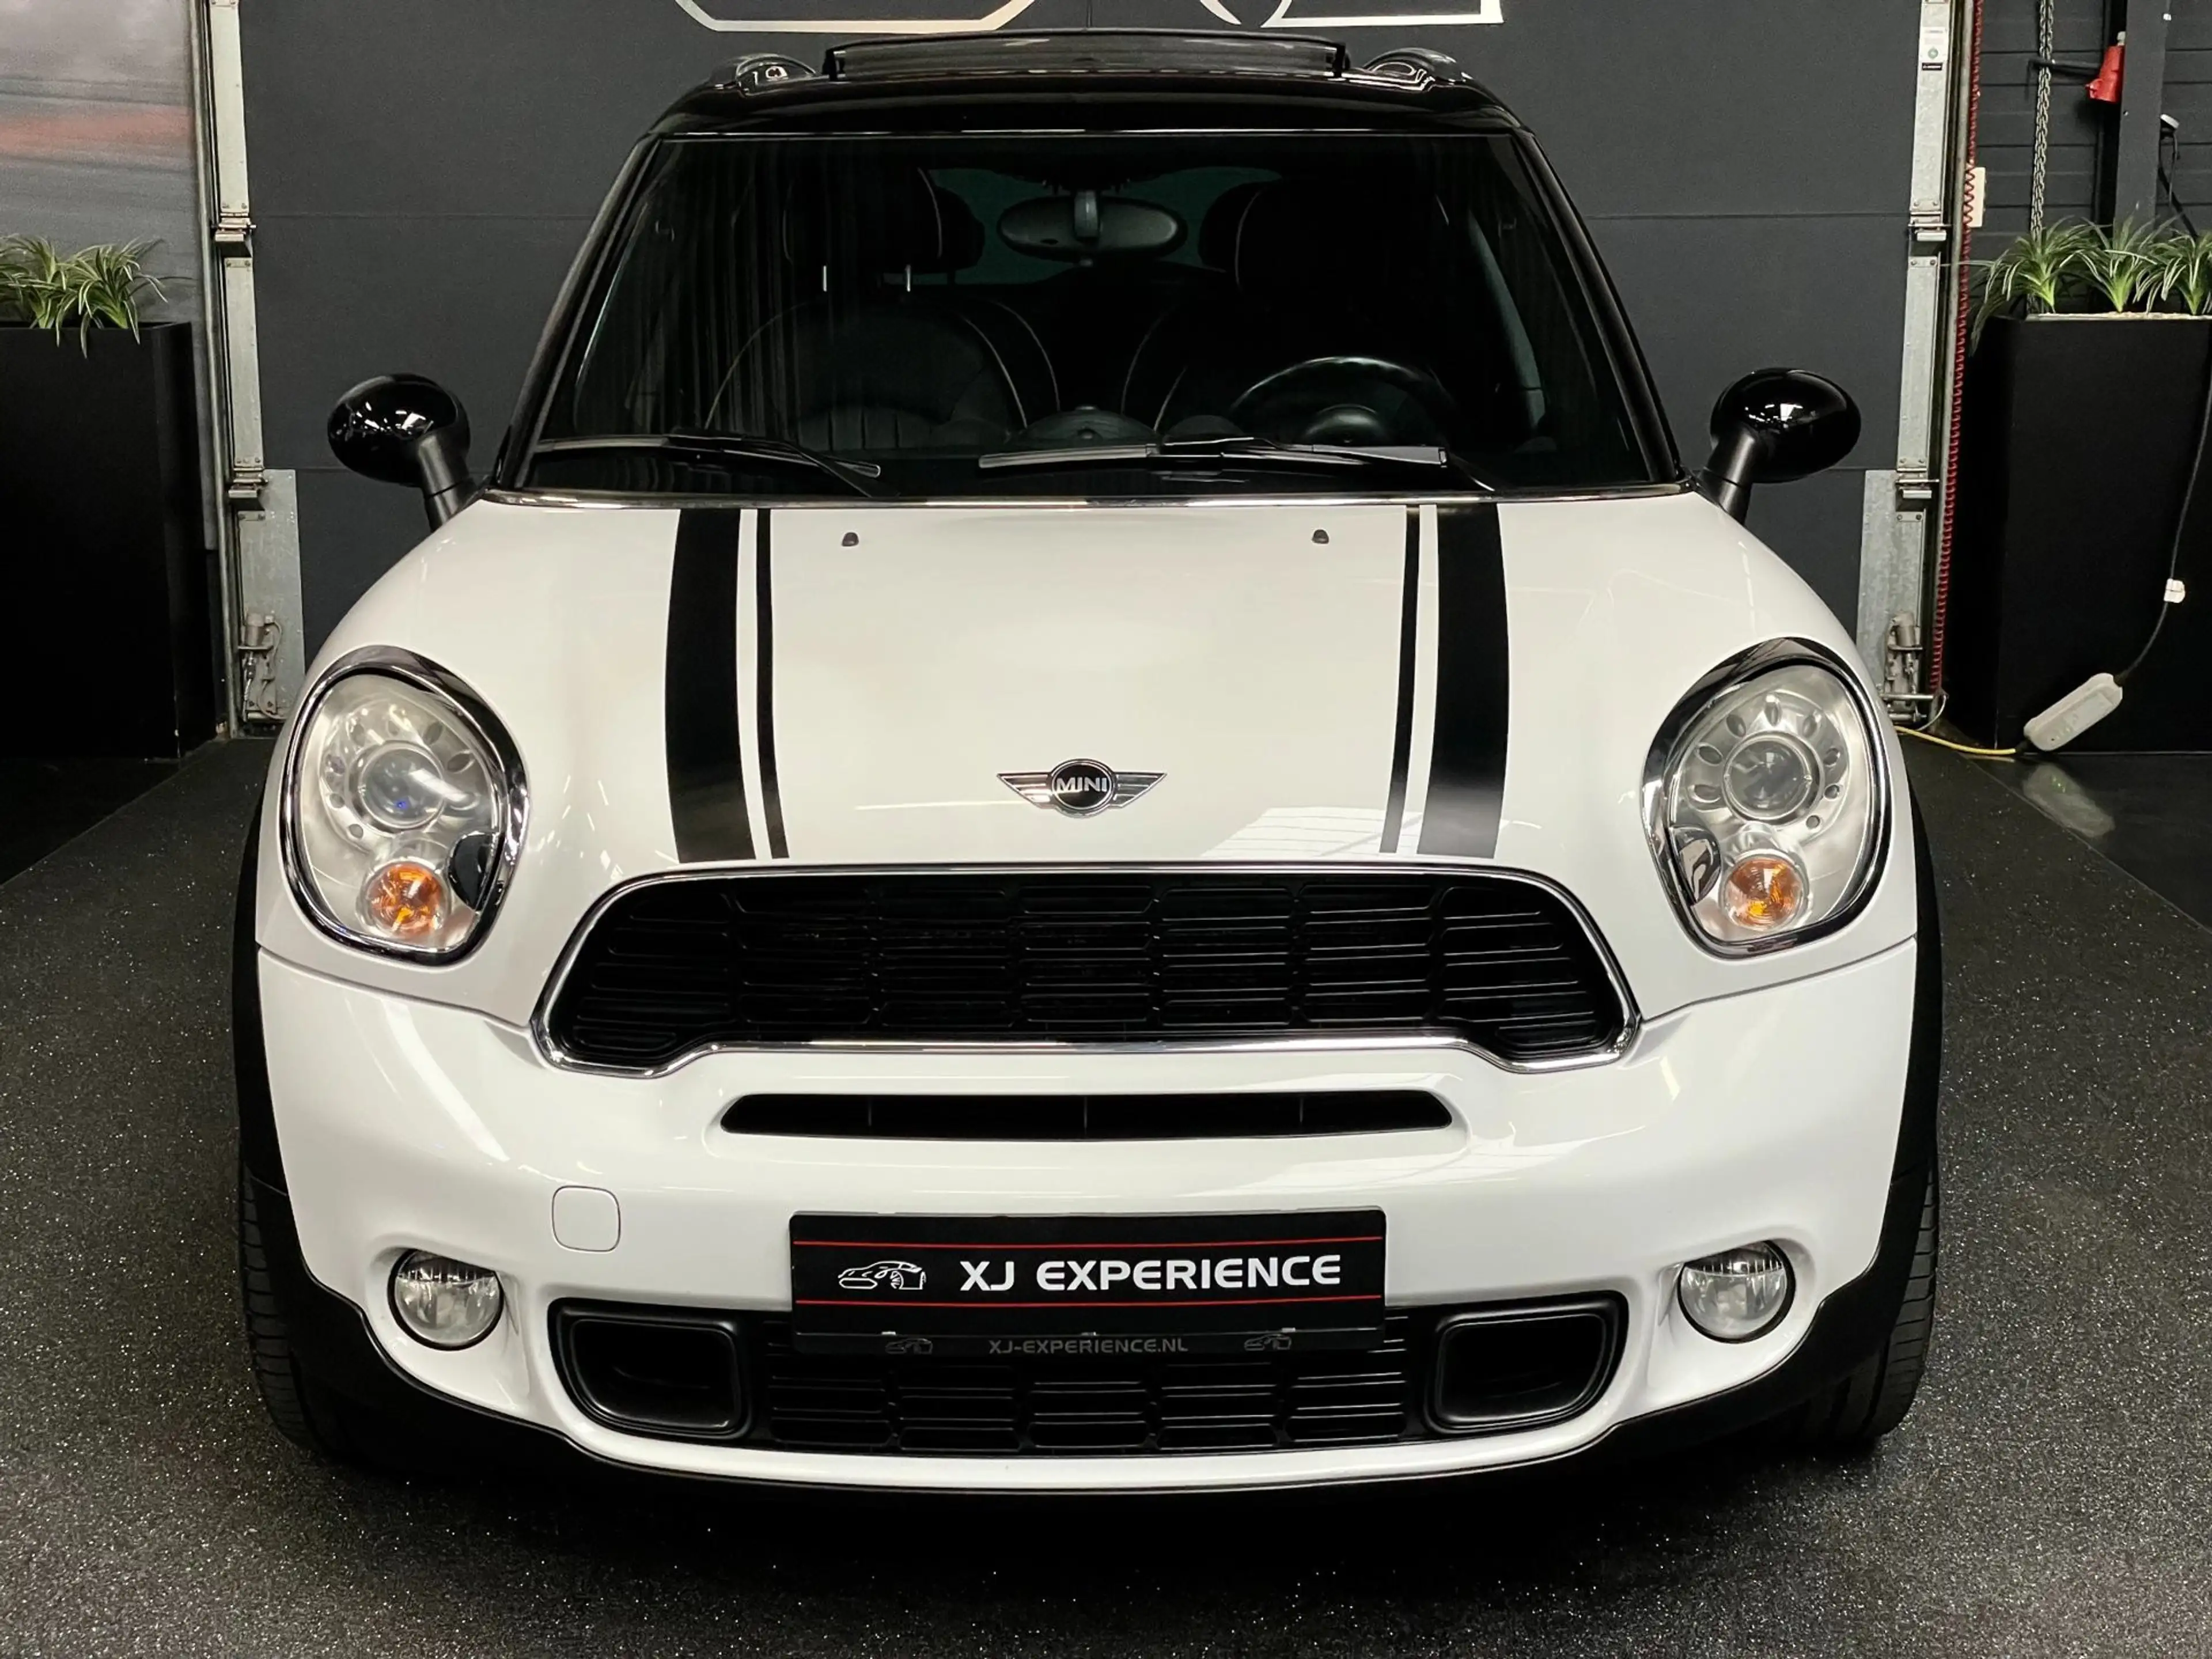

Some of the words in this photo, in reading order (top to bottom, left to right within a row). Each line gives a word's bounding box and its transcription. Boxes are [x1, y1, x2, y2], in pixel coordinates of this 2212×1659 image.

[1056, 777, 1108, 793] MINI
[960, 1260, 1014, 1291] XJ
[1036, 1254, 1340, 1291] EXPERIENCE
[988, 1338, 1189, 1354] XJ-EXPERIENCE.NL
